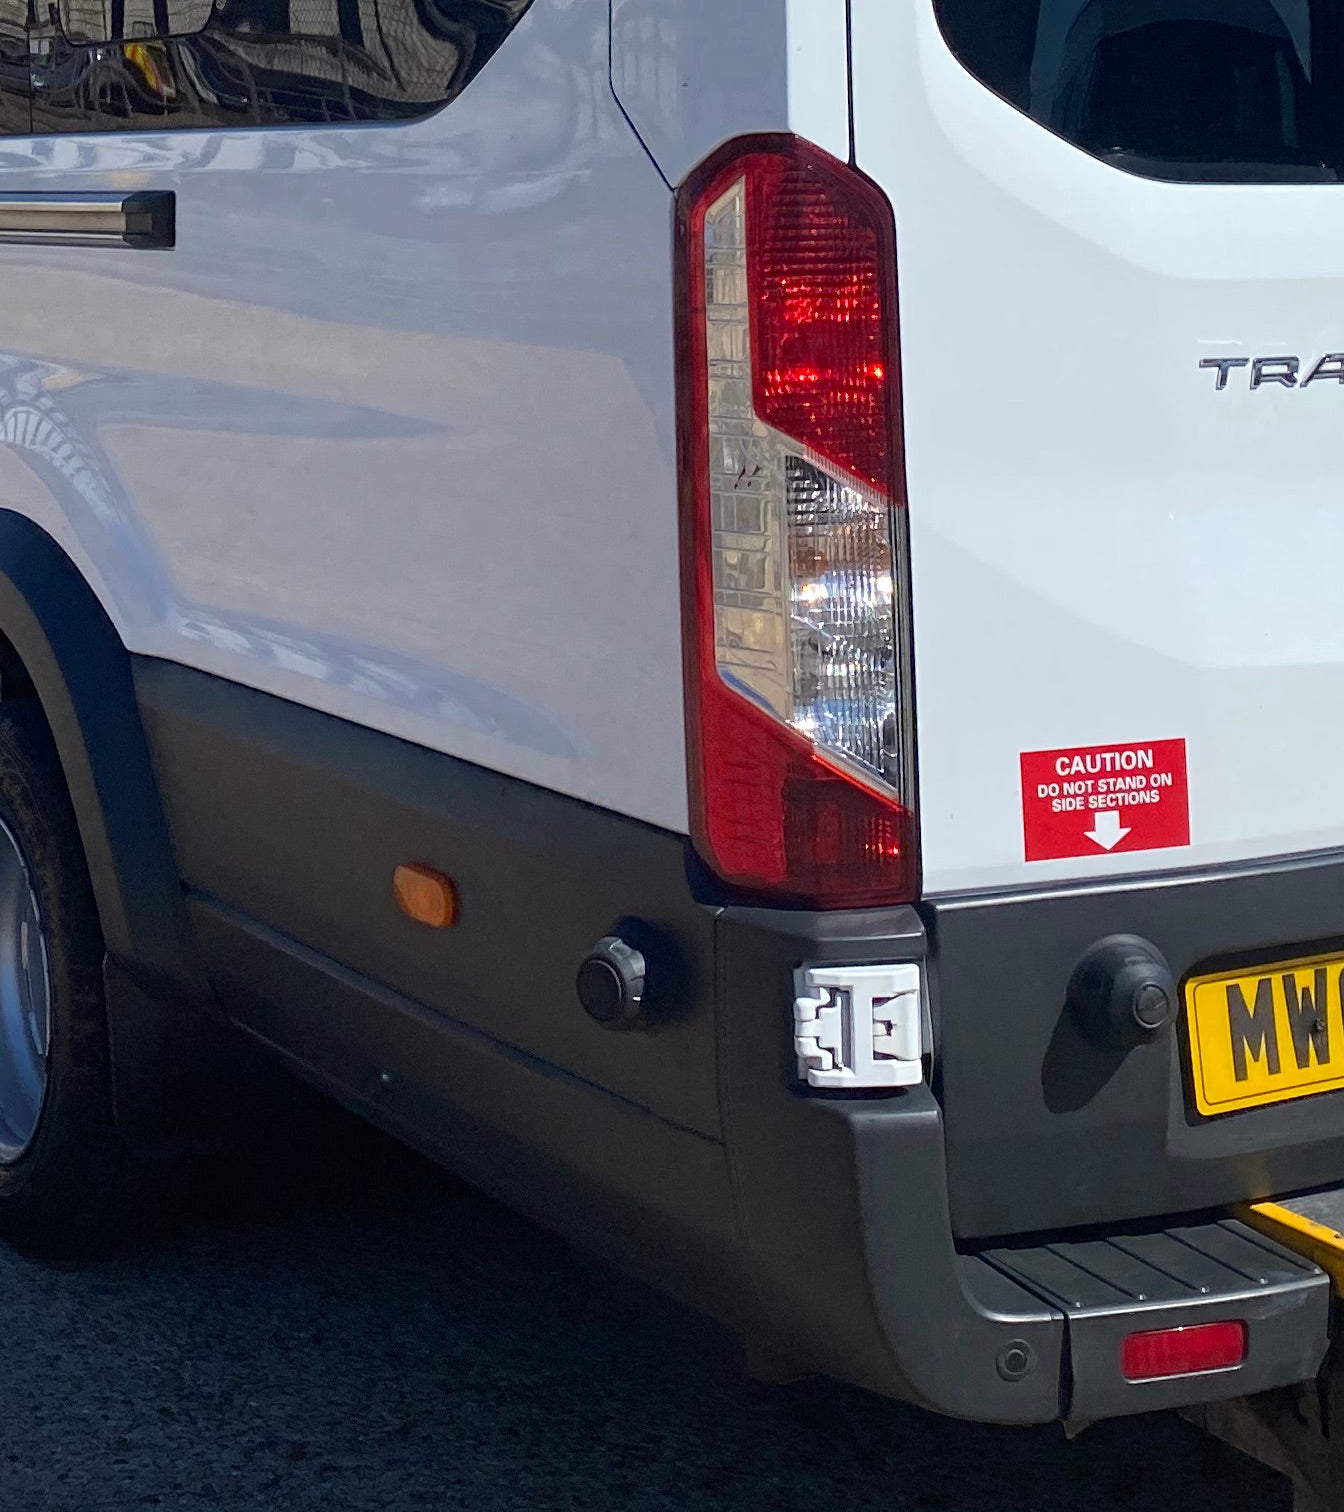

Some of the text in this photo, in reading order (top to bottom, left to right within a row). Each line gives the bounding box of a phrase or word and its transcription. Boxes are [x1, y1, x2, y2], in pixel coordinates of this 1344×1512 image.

[1055, 749, 1154, 776] CAUTION
[1037, 772, 1173, 798] DO NOT STAND ON
[1051, 790, 1161, 813] SIDE SECTIONS
